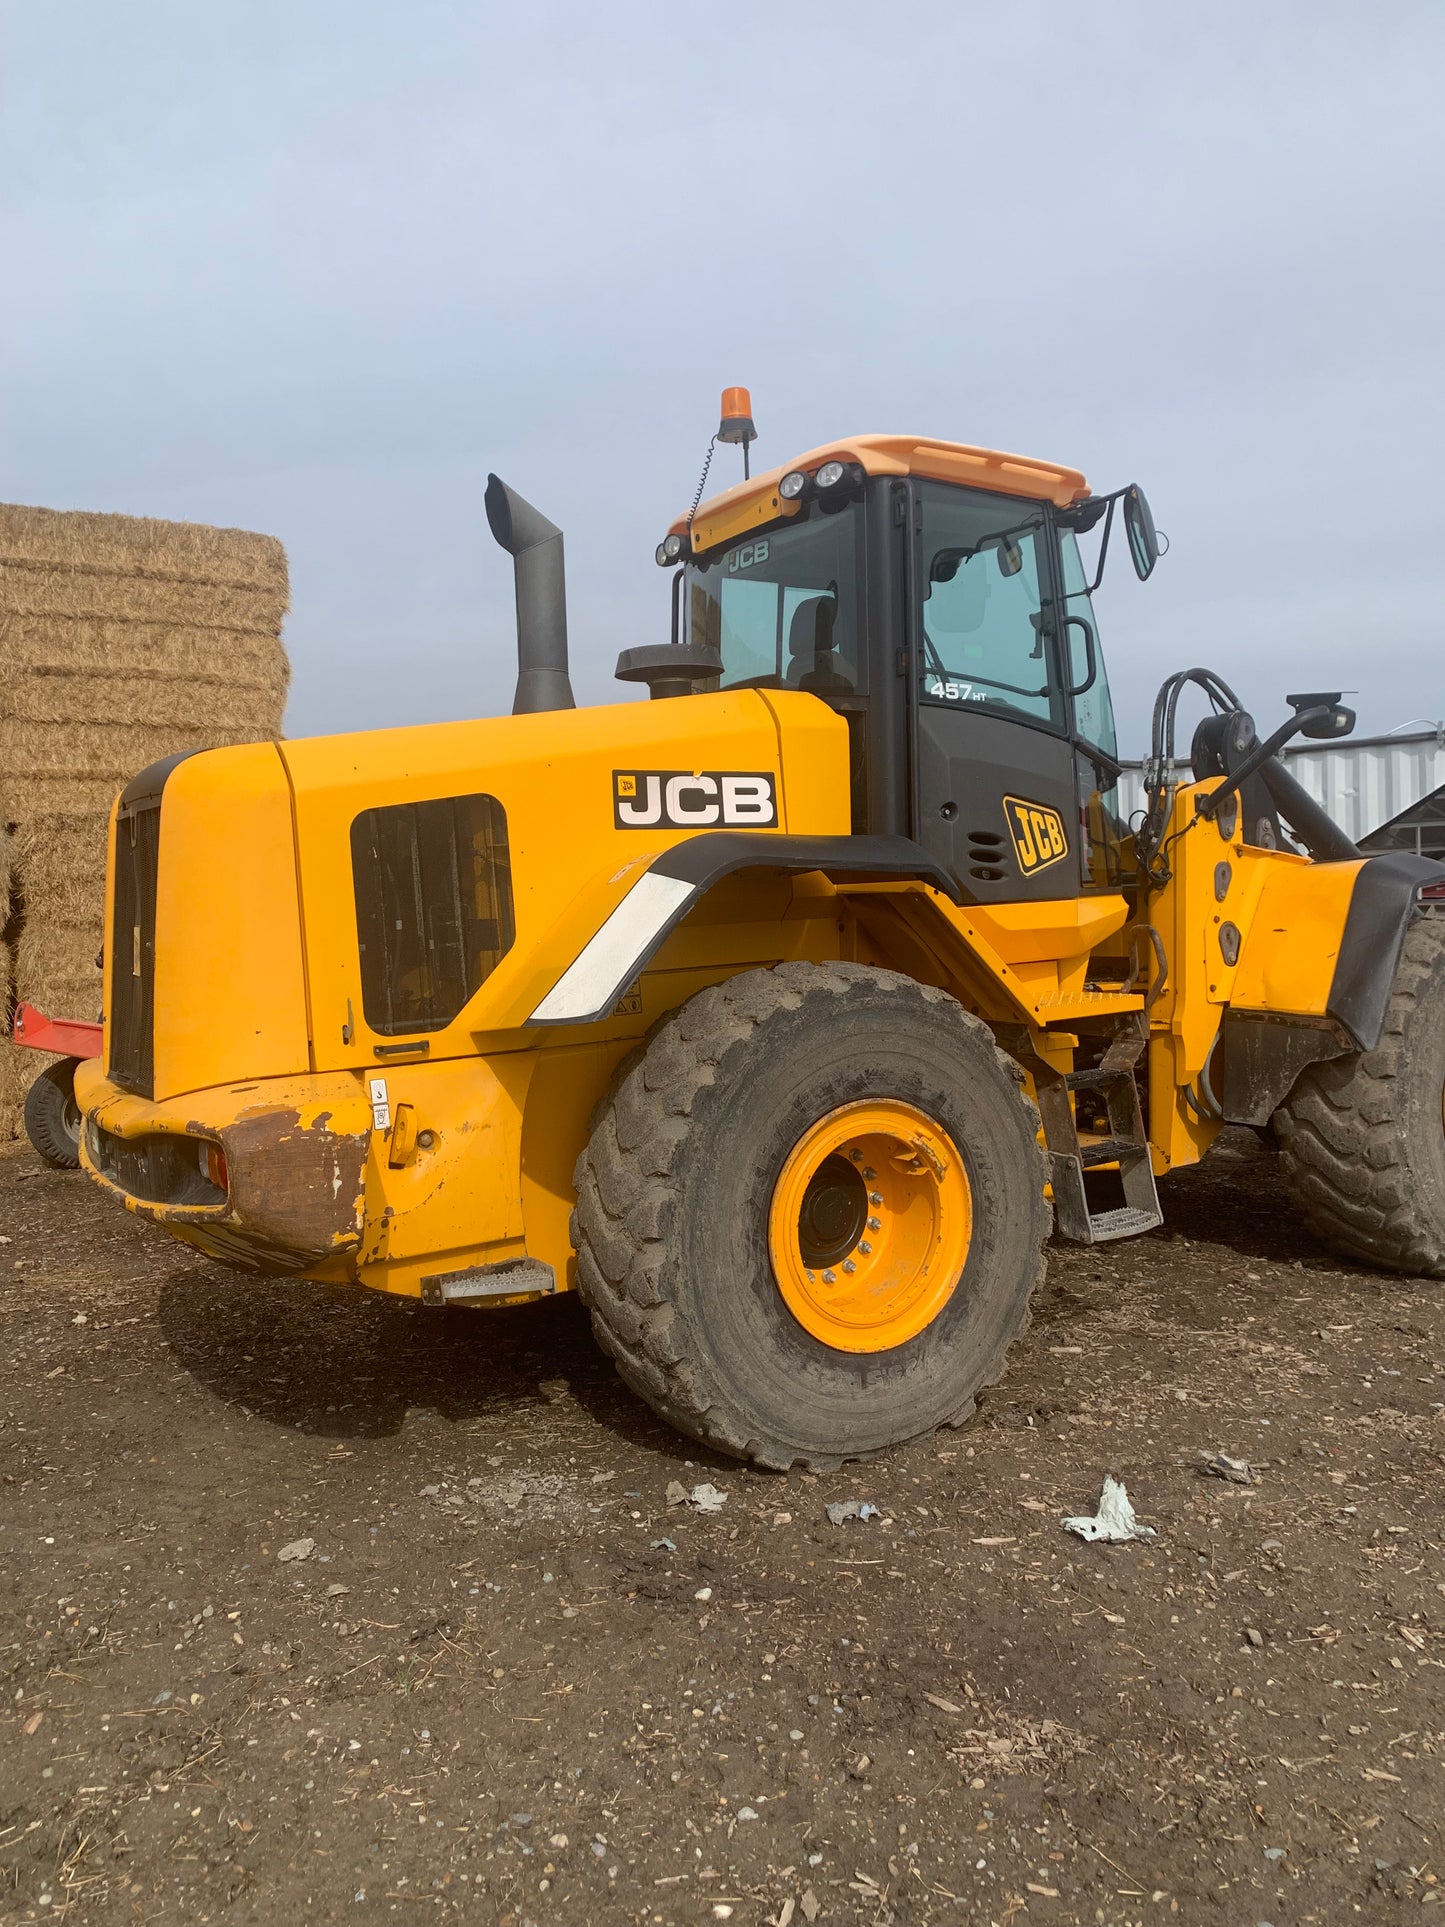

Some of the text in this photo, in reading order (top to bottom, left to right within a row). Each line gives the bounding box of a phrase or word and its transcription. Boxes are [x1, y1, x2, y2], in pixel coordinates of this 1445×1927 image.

[729, 540, 769, 573] JCB
[930, 681, 987, 701] 457 HT
[619, 775, 774, 825] JCB
[1014, 806, 1063, 868] JCB
